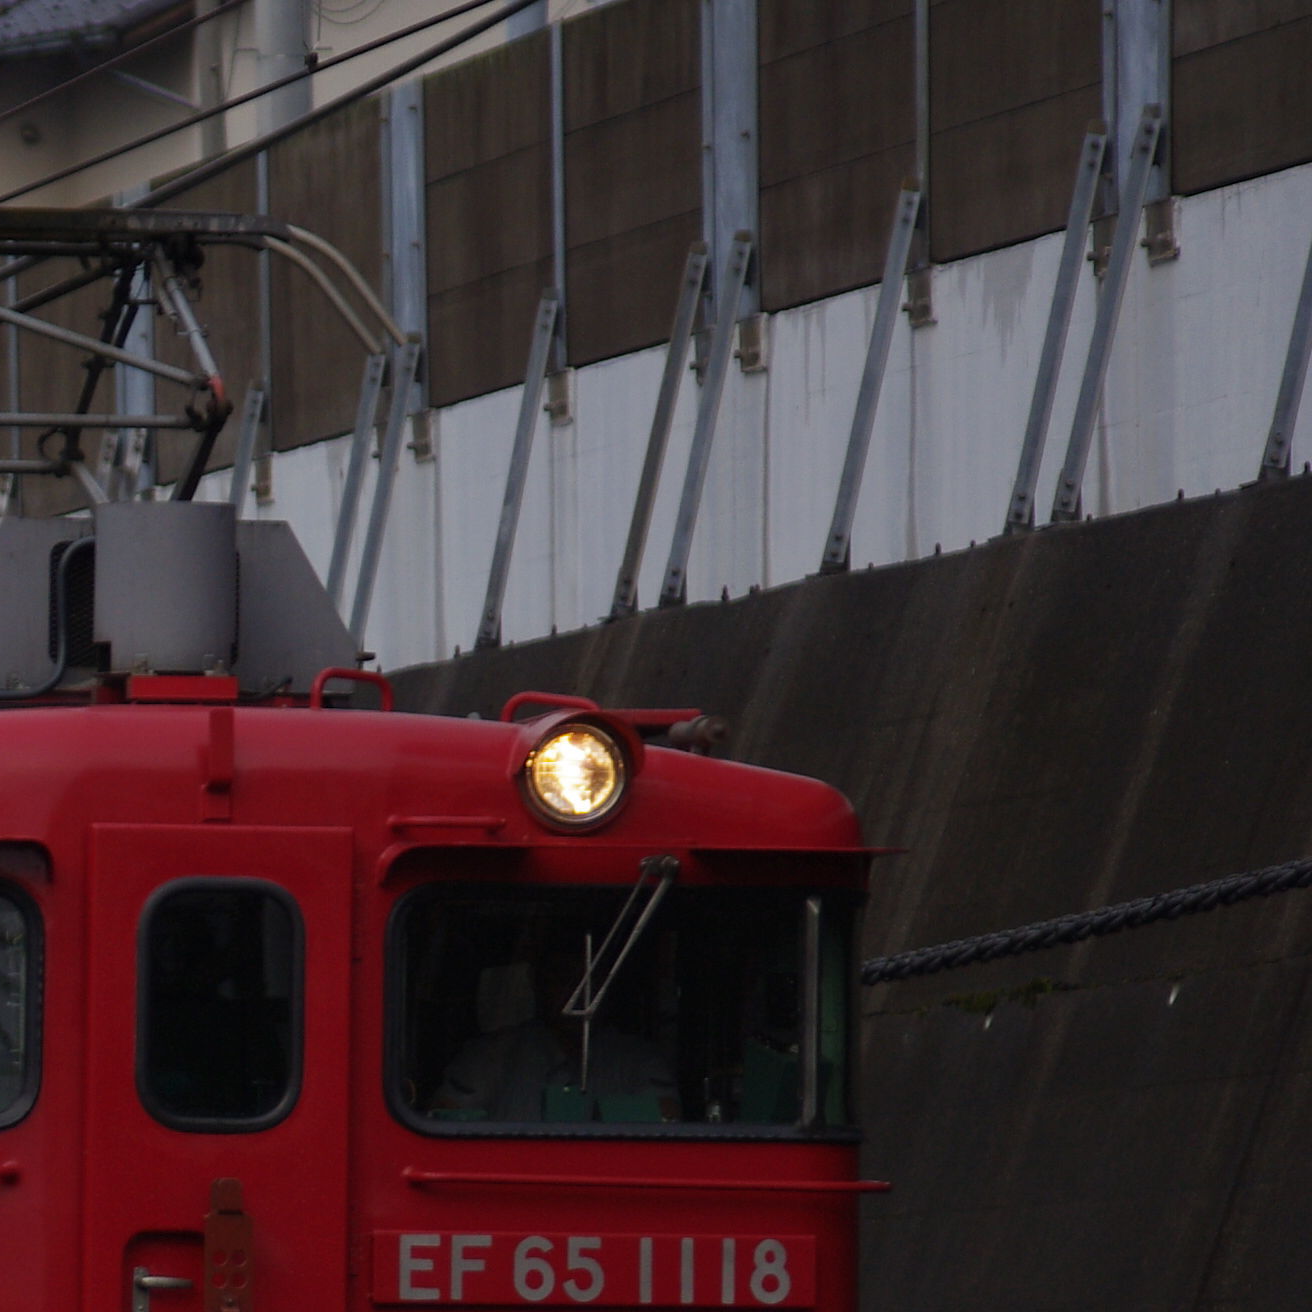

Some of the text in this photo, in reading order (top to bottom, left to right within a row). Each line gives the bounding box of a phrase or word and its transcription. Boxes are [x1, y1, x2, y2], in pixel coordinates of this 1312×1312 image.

[398, 1233, 792, 1304] EF 65 1118
